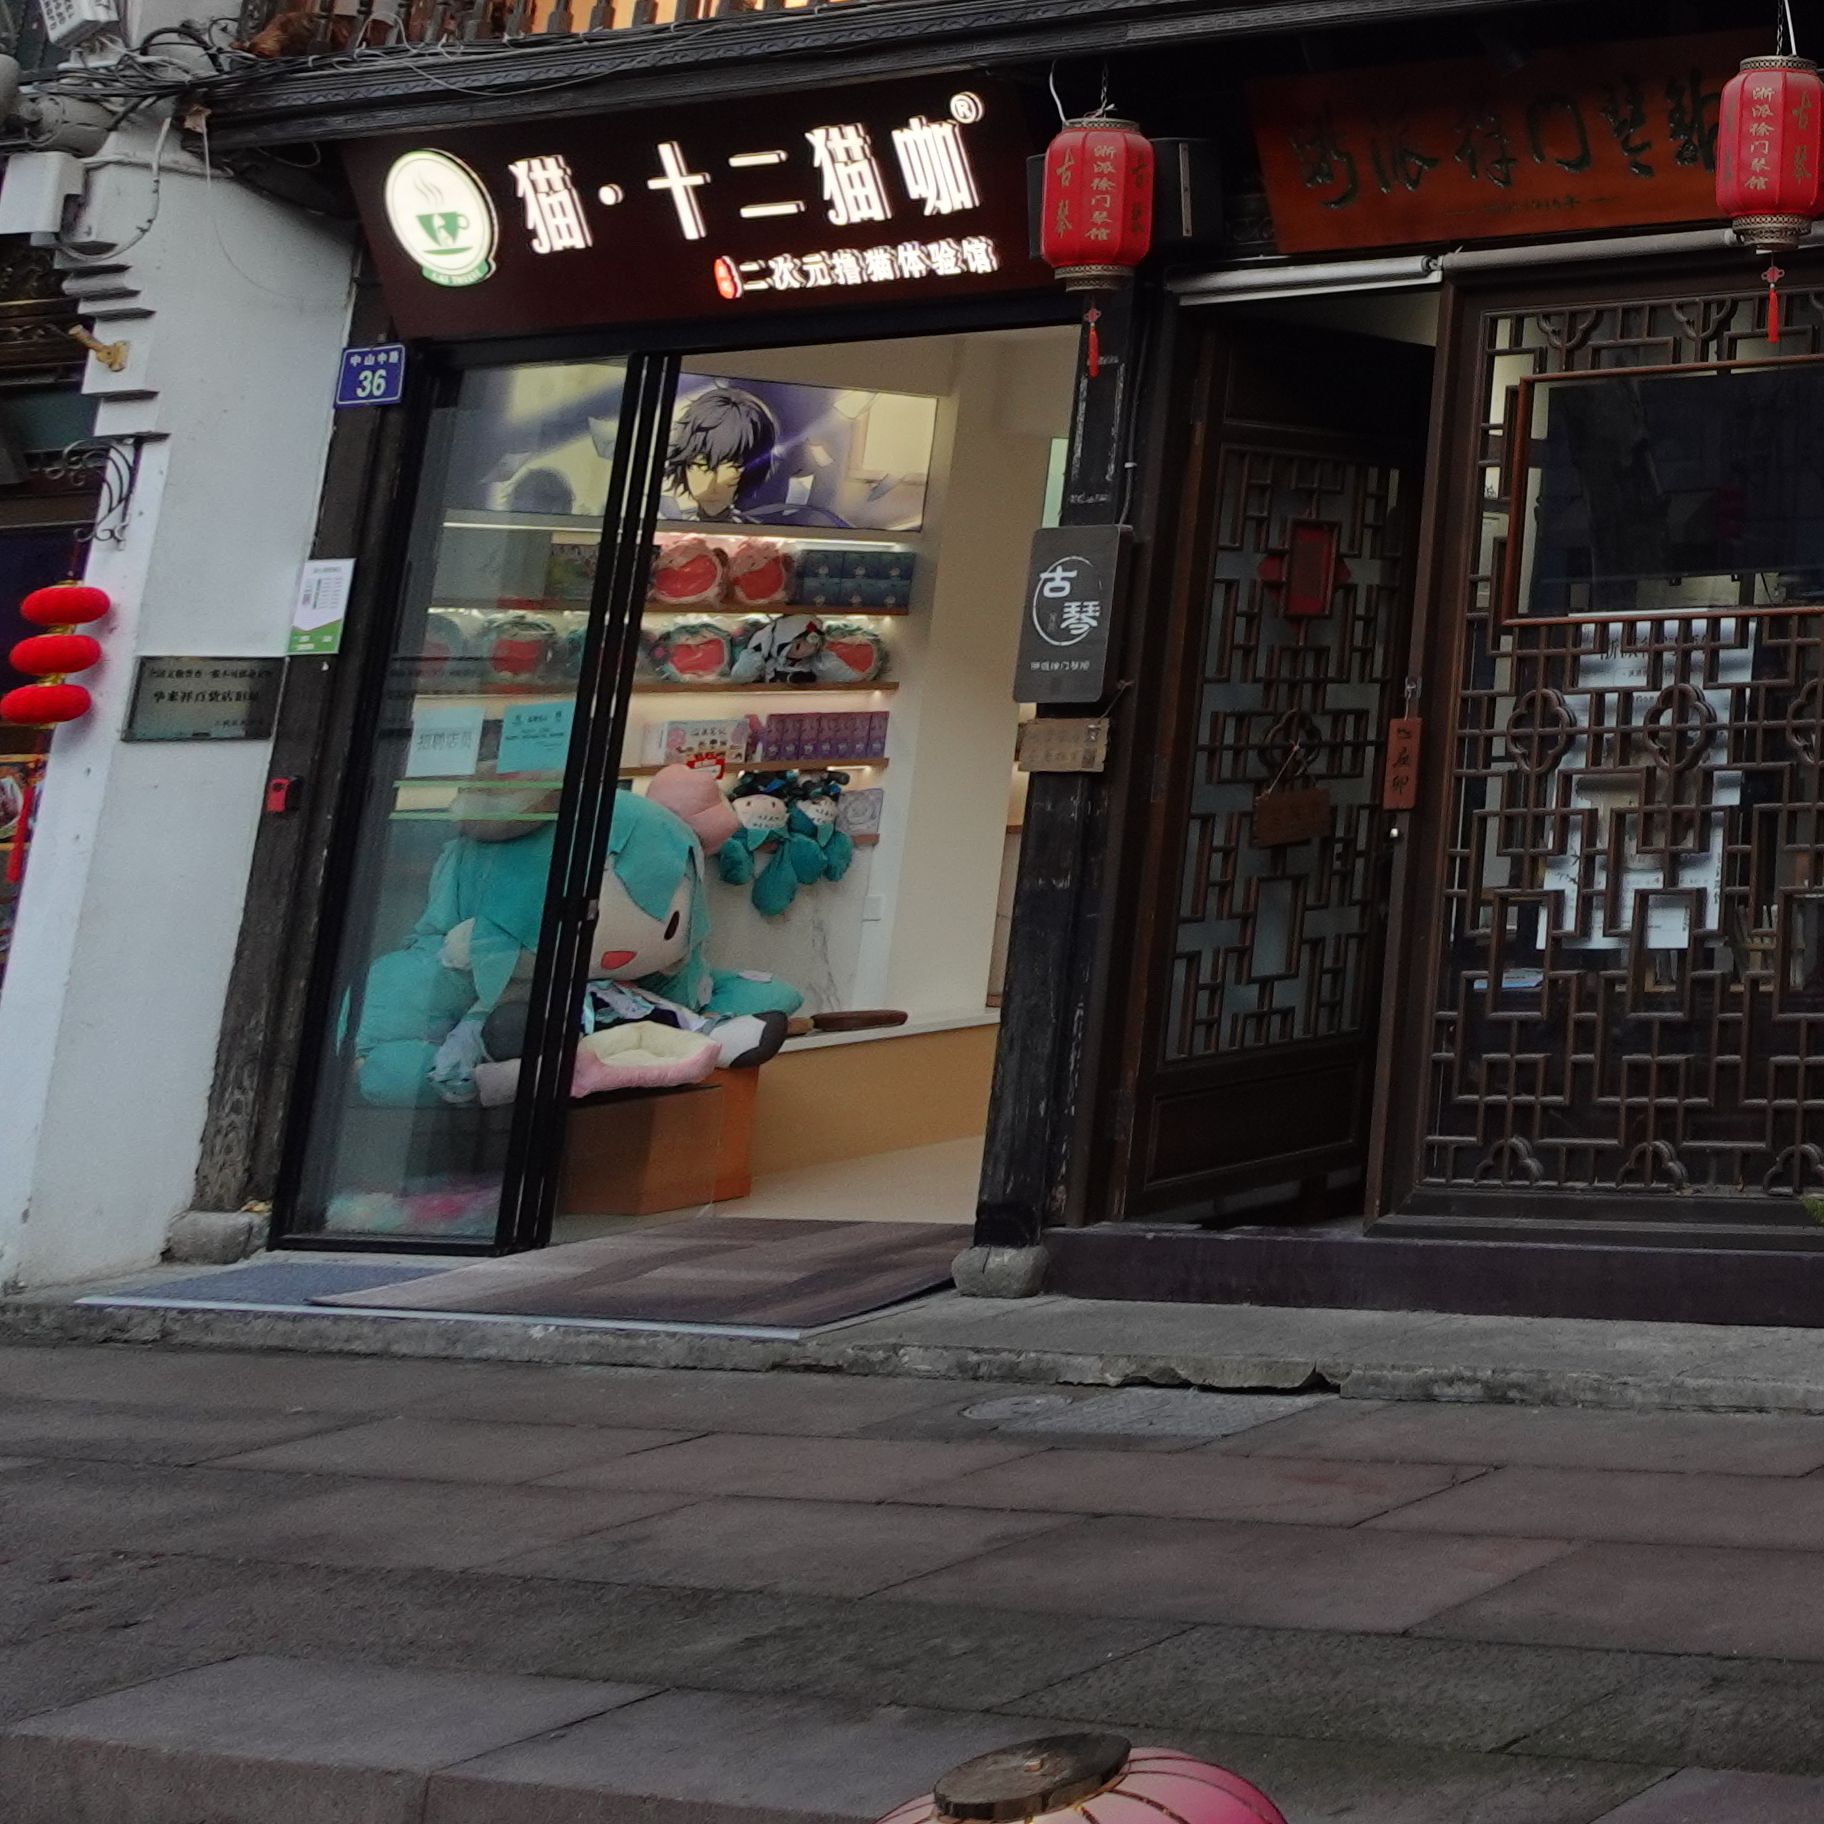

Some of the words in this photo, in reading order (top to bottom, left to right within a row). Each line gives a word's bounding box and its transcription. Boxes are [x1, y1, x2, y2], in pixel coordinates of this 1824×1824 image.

[738, 236, 1001, 292] 二次元撸猫体验馆
[350, 350, 400, 367] 中山中路
[356, 368, 388, 398] 36
[1039, 564, 1101, 636] 古琴
